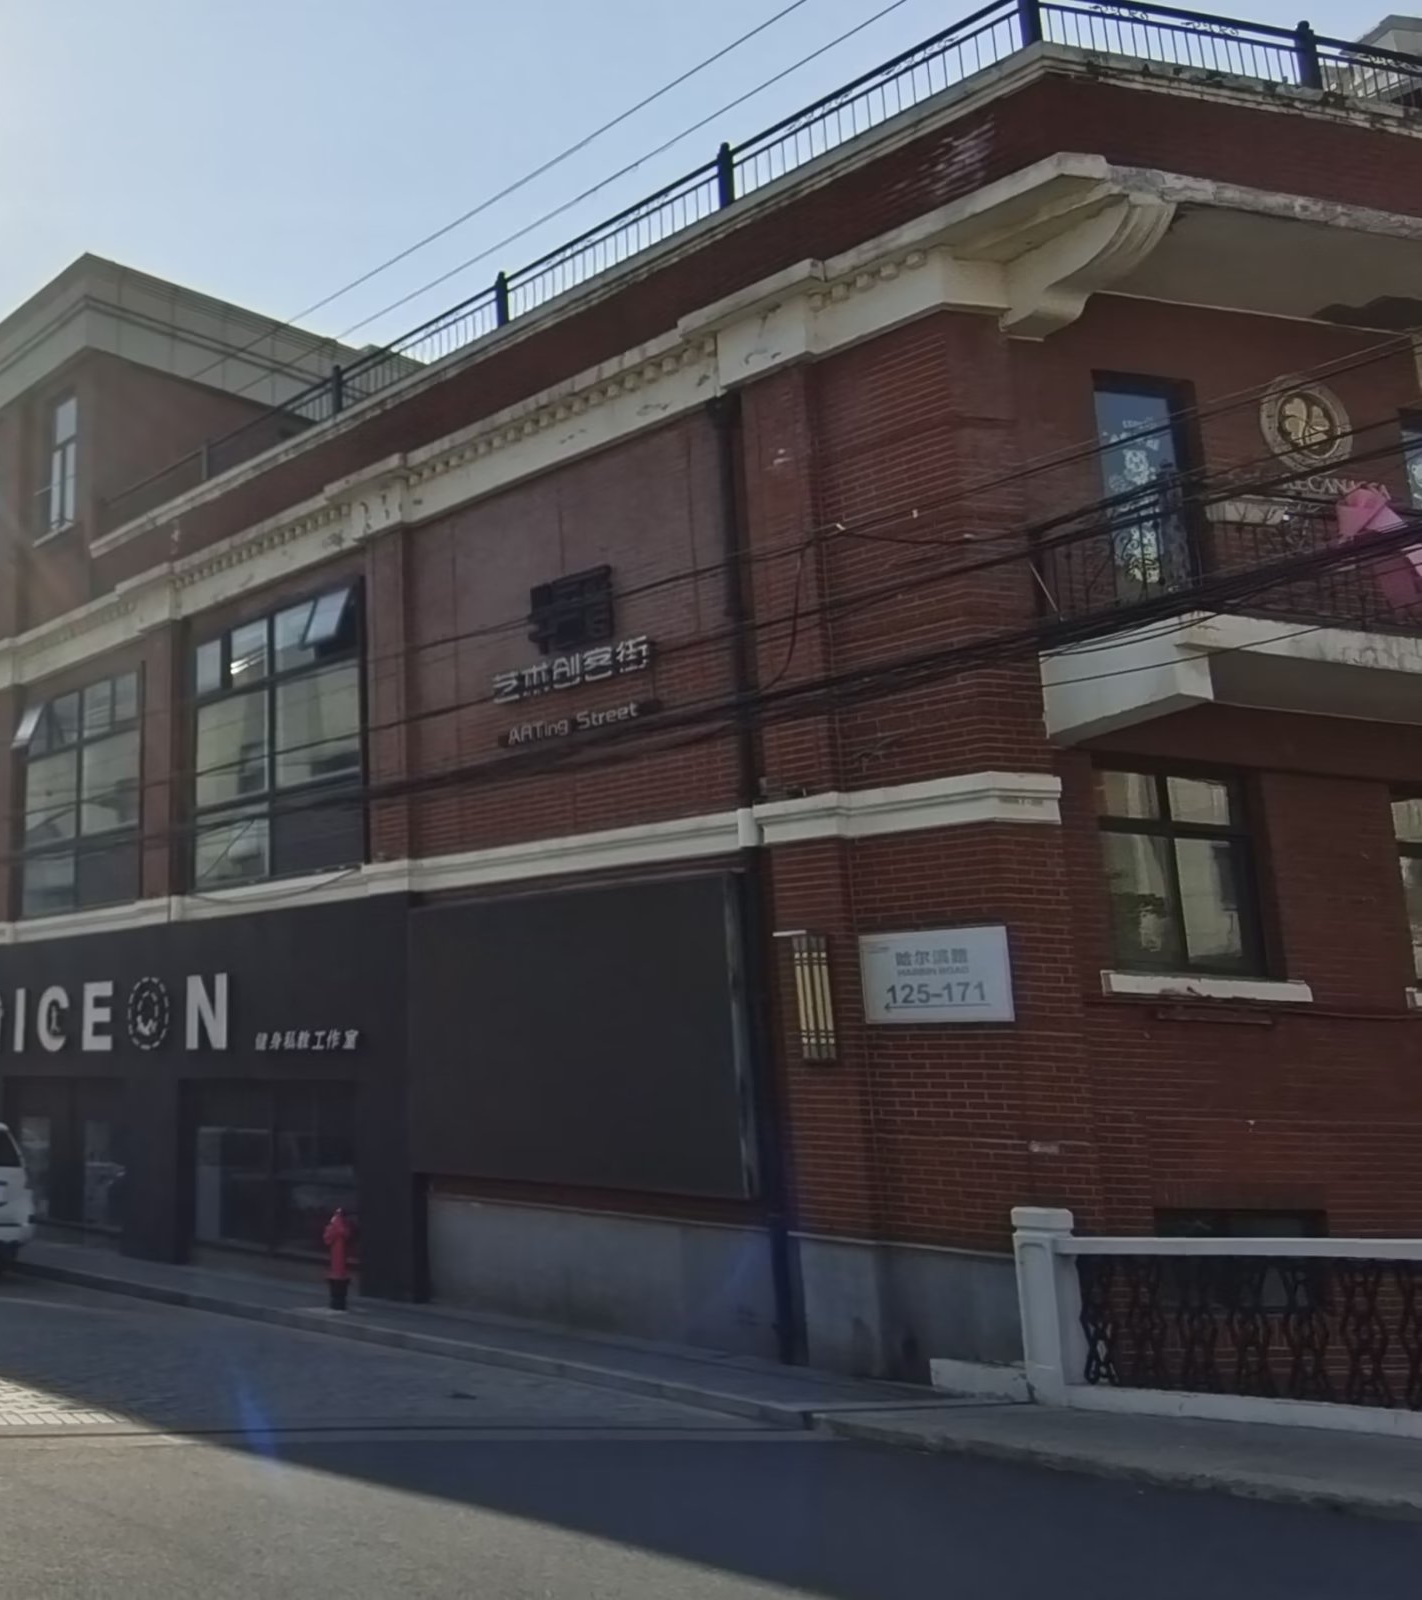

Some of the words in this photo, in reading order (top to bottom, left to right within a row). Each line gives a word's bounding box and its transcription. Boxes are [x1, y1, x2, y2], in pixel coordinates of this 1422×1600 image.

[492, 635, 649, 704] 艺术创客街
[508, 718, 569, 746] ARTing
[576, 702, 639, 730] Street
[886, 981, 986, 1004] 125-171
[255, 1028, 359, 1051] 健身私教工作室
